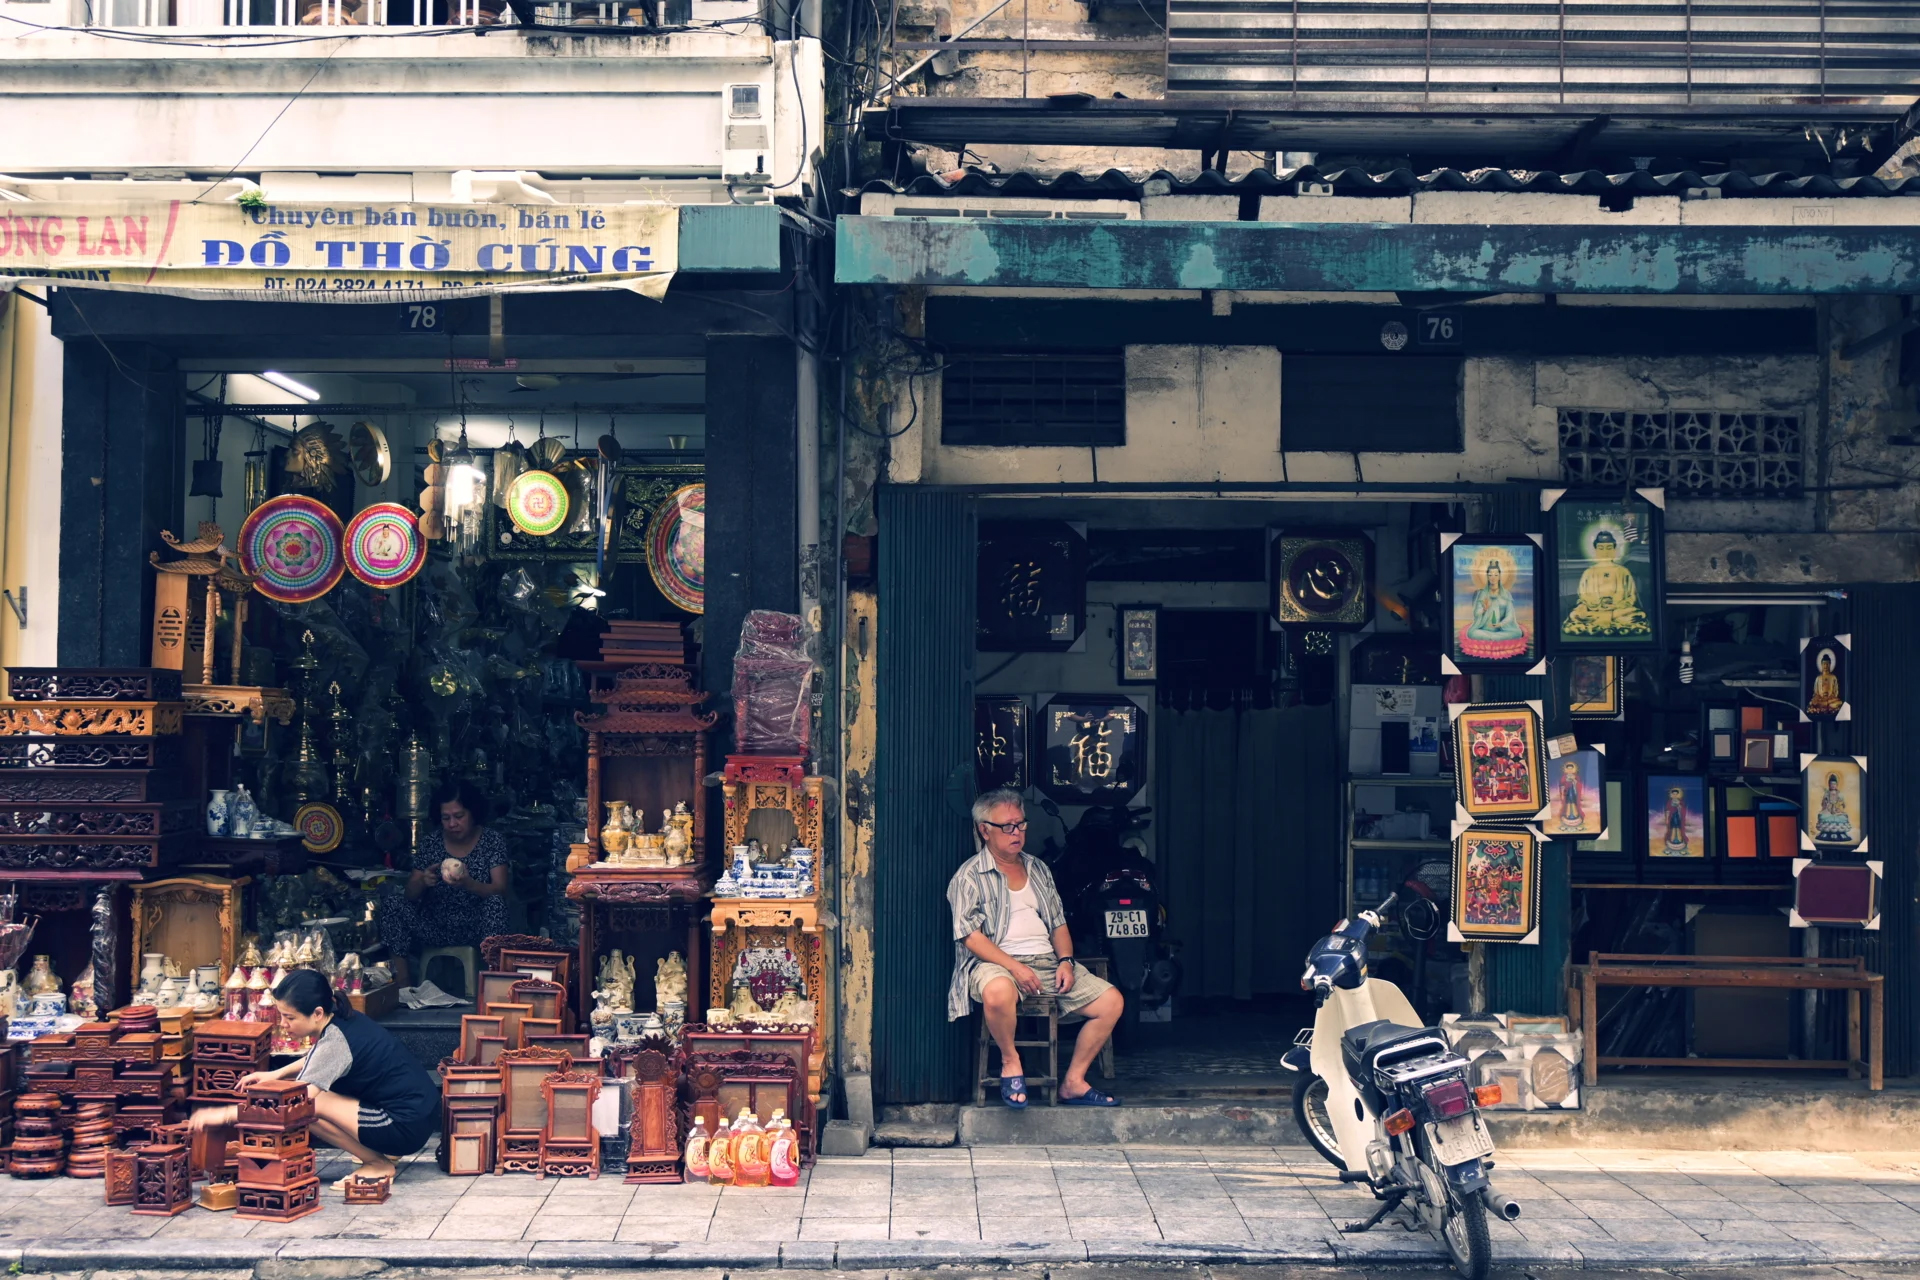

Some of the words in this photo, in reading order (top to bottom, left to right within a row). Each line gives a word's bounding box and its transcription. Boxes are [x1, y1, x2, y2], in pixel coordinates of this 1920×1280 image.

[251, 205, 354, 228] Chuyên
[365, 206, 417, 226] bán
[427, 208, 507, 231] buôn,
[518, 208, 570, 229] bán
[580, 208, 606, 230] lẻ
[76, 216, 149, 256] LAN
[201, 231, 291, 268] ĐỒ
[315, 235, 452, 271] THỜ
[476, 237, 655, 273] CÚNG
[408, 305, 436, 328] 78
[1427, 317, 1454, 340] 76
[1110, 911, 1141, 924] 29-C1
[1108, 923, 1147, 936] 748.68
